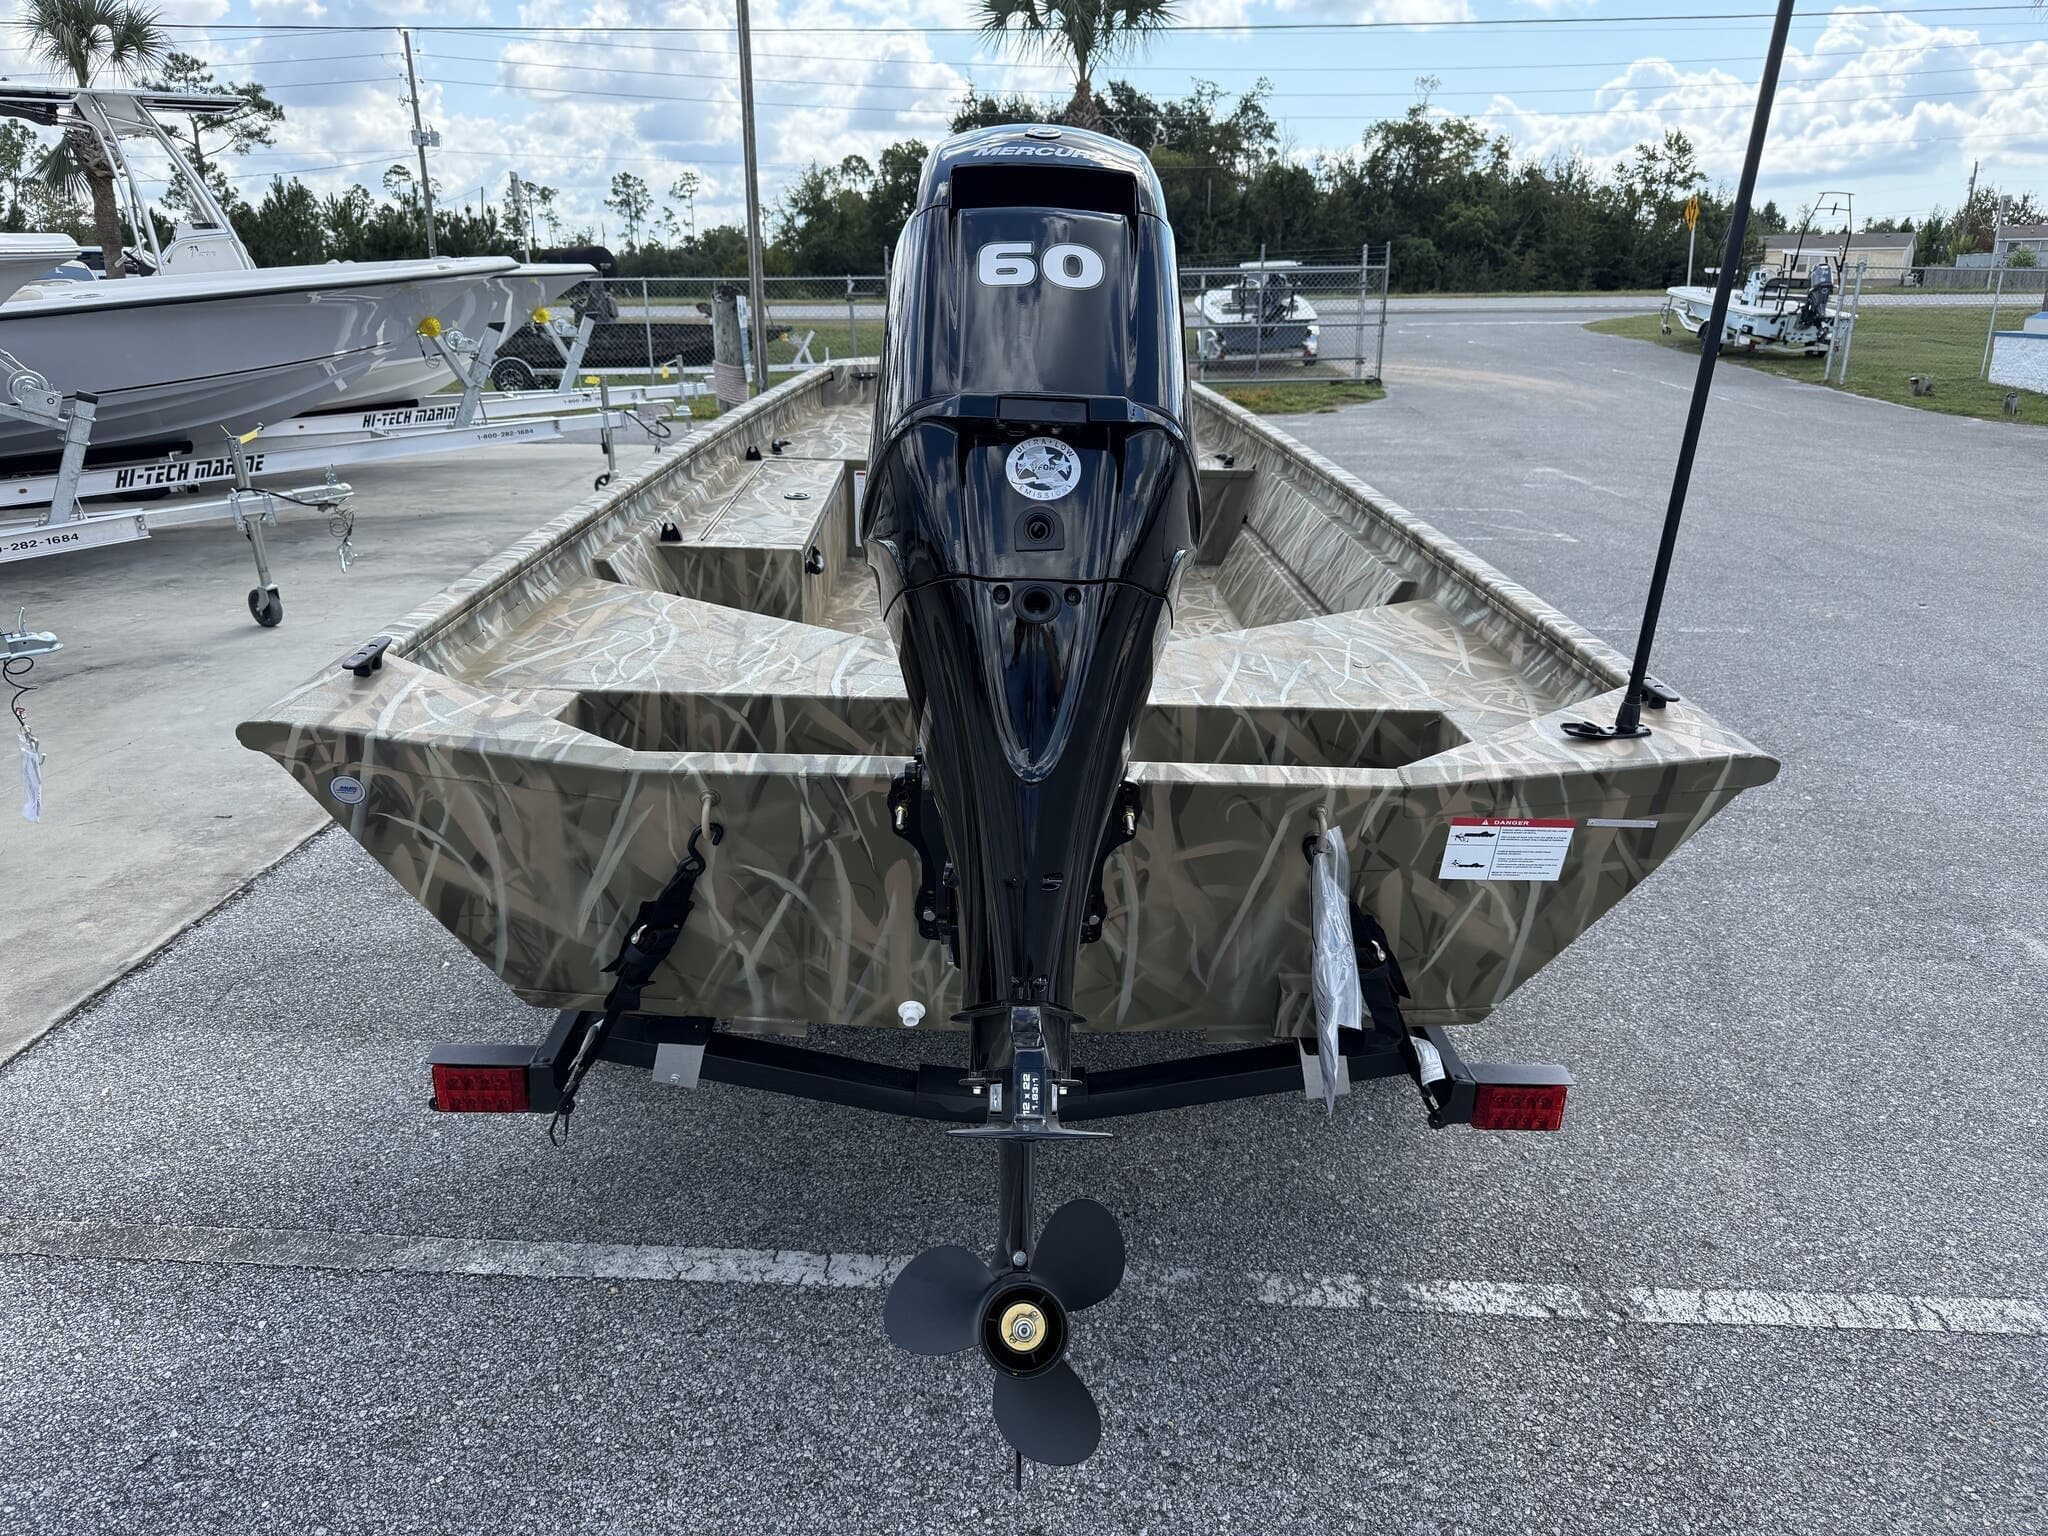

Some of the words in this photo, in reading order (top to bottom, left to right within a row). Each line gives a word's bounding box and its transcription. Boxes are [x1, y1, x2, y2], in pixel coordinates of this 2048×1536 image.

[977, 241, 1105, 290] 60
[362, 410, 412, 428] HI-TECH
[415, 406, 460, 423] MARIN
[1054, 441, 1075, 457] LOW
[115, 462, 189, 488] HI-TECH
[194, 455, 264, 479] MARNE
[1023, 1073, 1030, 1090] 22
[1023, 1102, 1030, 1116] 12
